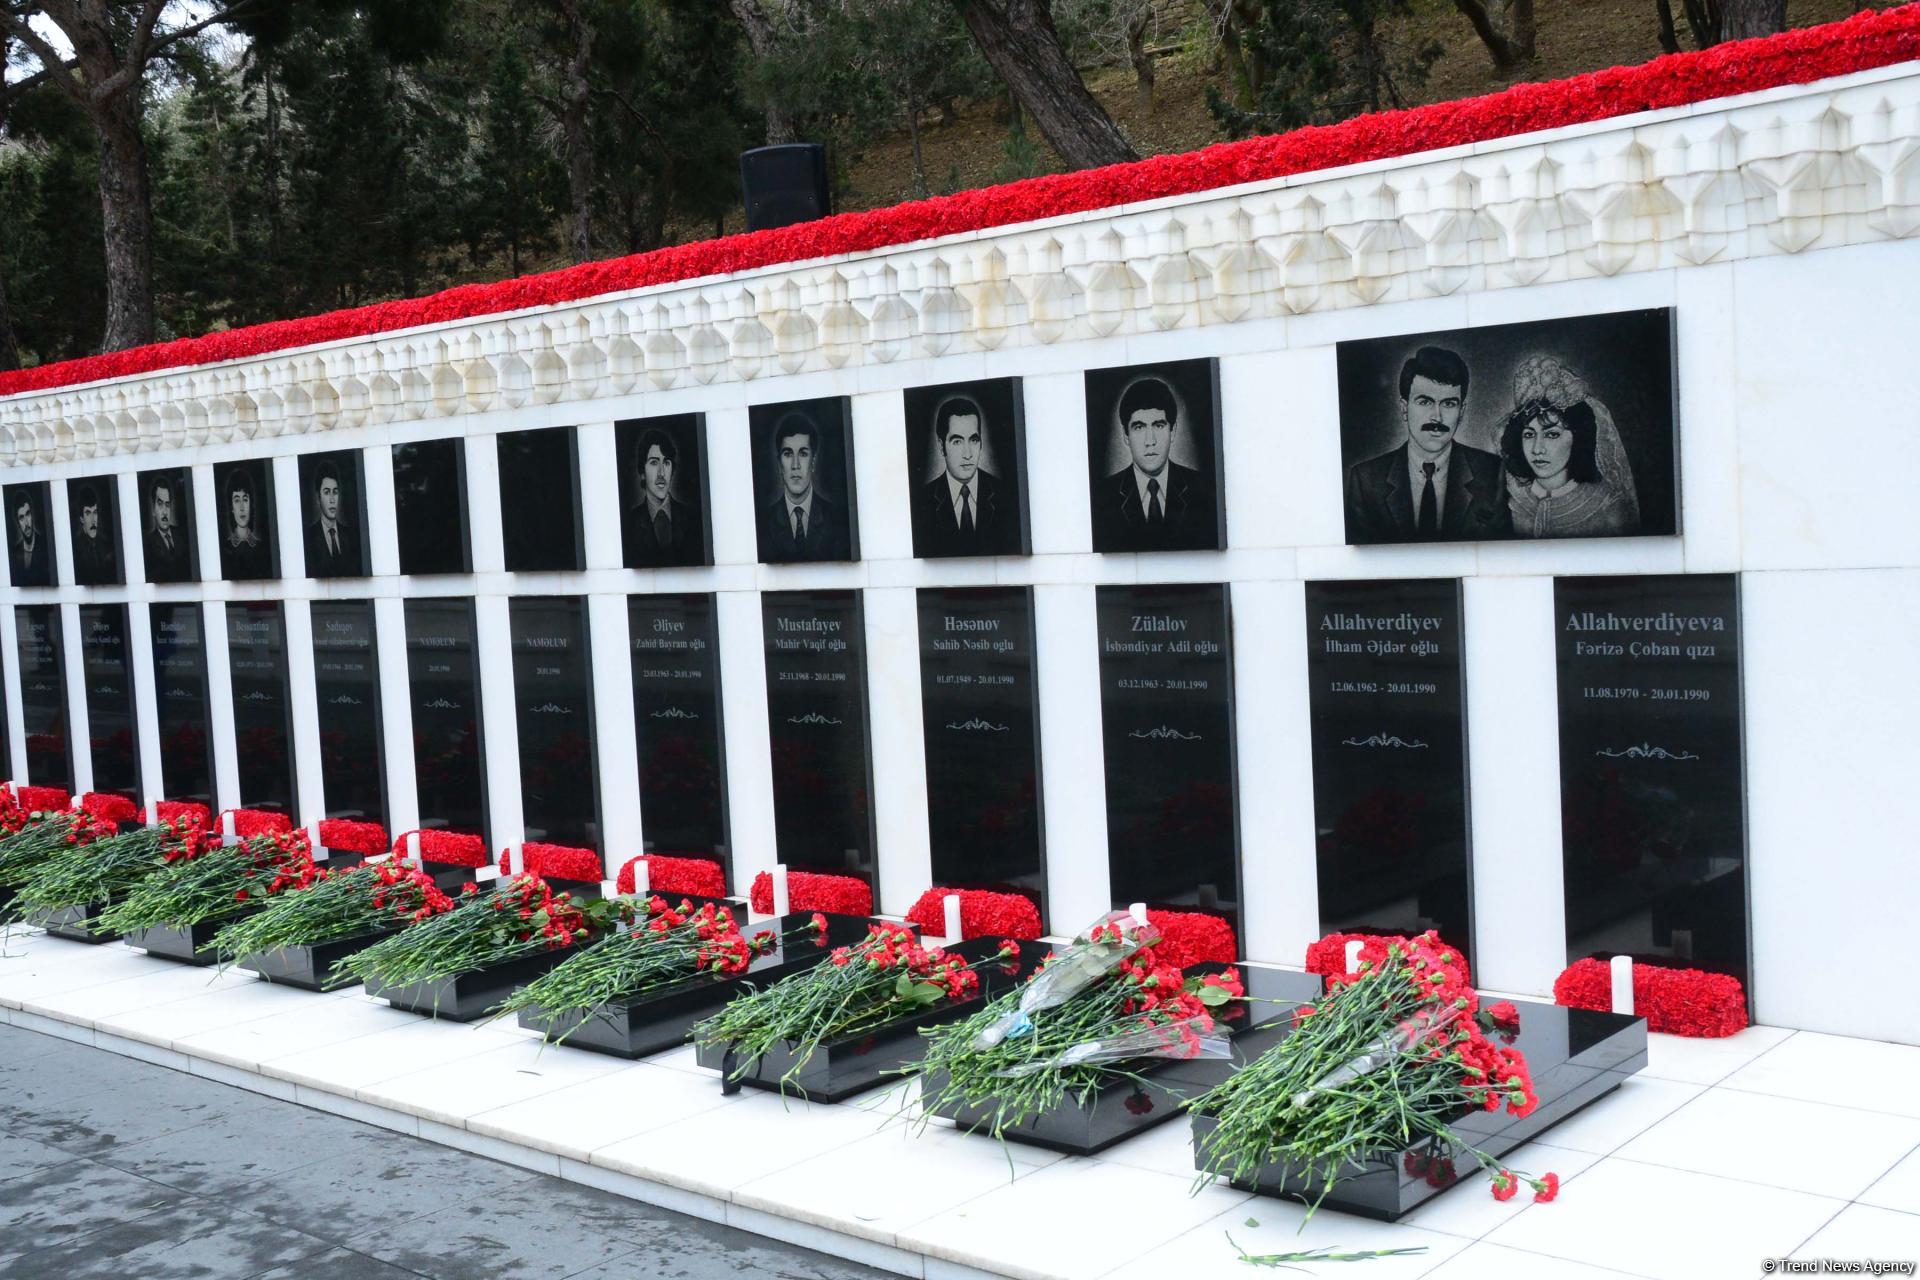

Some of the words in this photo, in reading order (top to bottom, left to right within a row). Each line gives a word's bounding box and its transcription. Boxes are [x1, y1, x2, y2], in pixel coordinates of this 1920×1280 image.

[653, 618, 685, 635] Əliyev
[776, 617, 842, 635] Mustafayev
[943, 616, 1001, 631] Həsənov
[1131, 615, 1188, 632] Zülalov
[1320, 613, 1443, 635] Allahverdiyev
[1566, 612, 1725, 636] Allahverdiyeva
[636, 638, 657, 649] Zahid
[775, 638, 801, 649] Mahir
[802, 638, 827, 652] Vaqif
[828, 638, 847, 652] oğlu
[933, 639, 960, 650] Sahib
[963, 639, 990, 650] Nəsib
[1167, 640, 1190, 652] Adil
[1194, 640, 1218, 656] oğlu
[1325, 637, 1363, 653] İlham
[1367, 639, 1406, 656] Əjdər
[1410, 639, 1439, 657] oğlu
[1576, 641, 1624, 655] Fərizə
[1629, 641, 1681, 659] Çoban
[1686, 645, 1716, 660] qızı
[815, 672, 846, 682] 20.01.1990
[978, 675, 1015, 685] 20.01.1990
[1118, 679, 1159, 689] 03.12.1963
[1166, 679, 1208, 690] 20.01.1990
[1330, 682, 1377, 693] 12.06.1962
[1387, 683, 1436, 694] 20.01.1990
[1583, 687, 1639, 698] 11.08.1970
[1651, 688, 1710, 700] 20.01.1990
